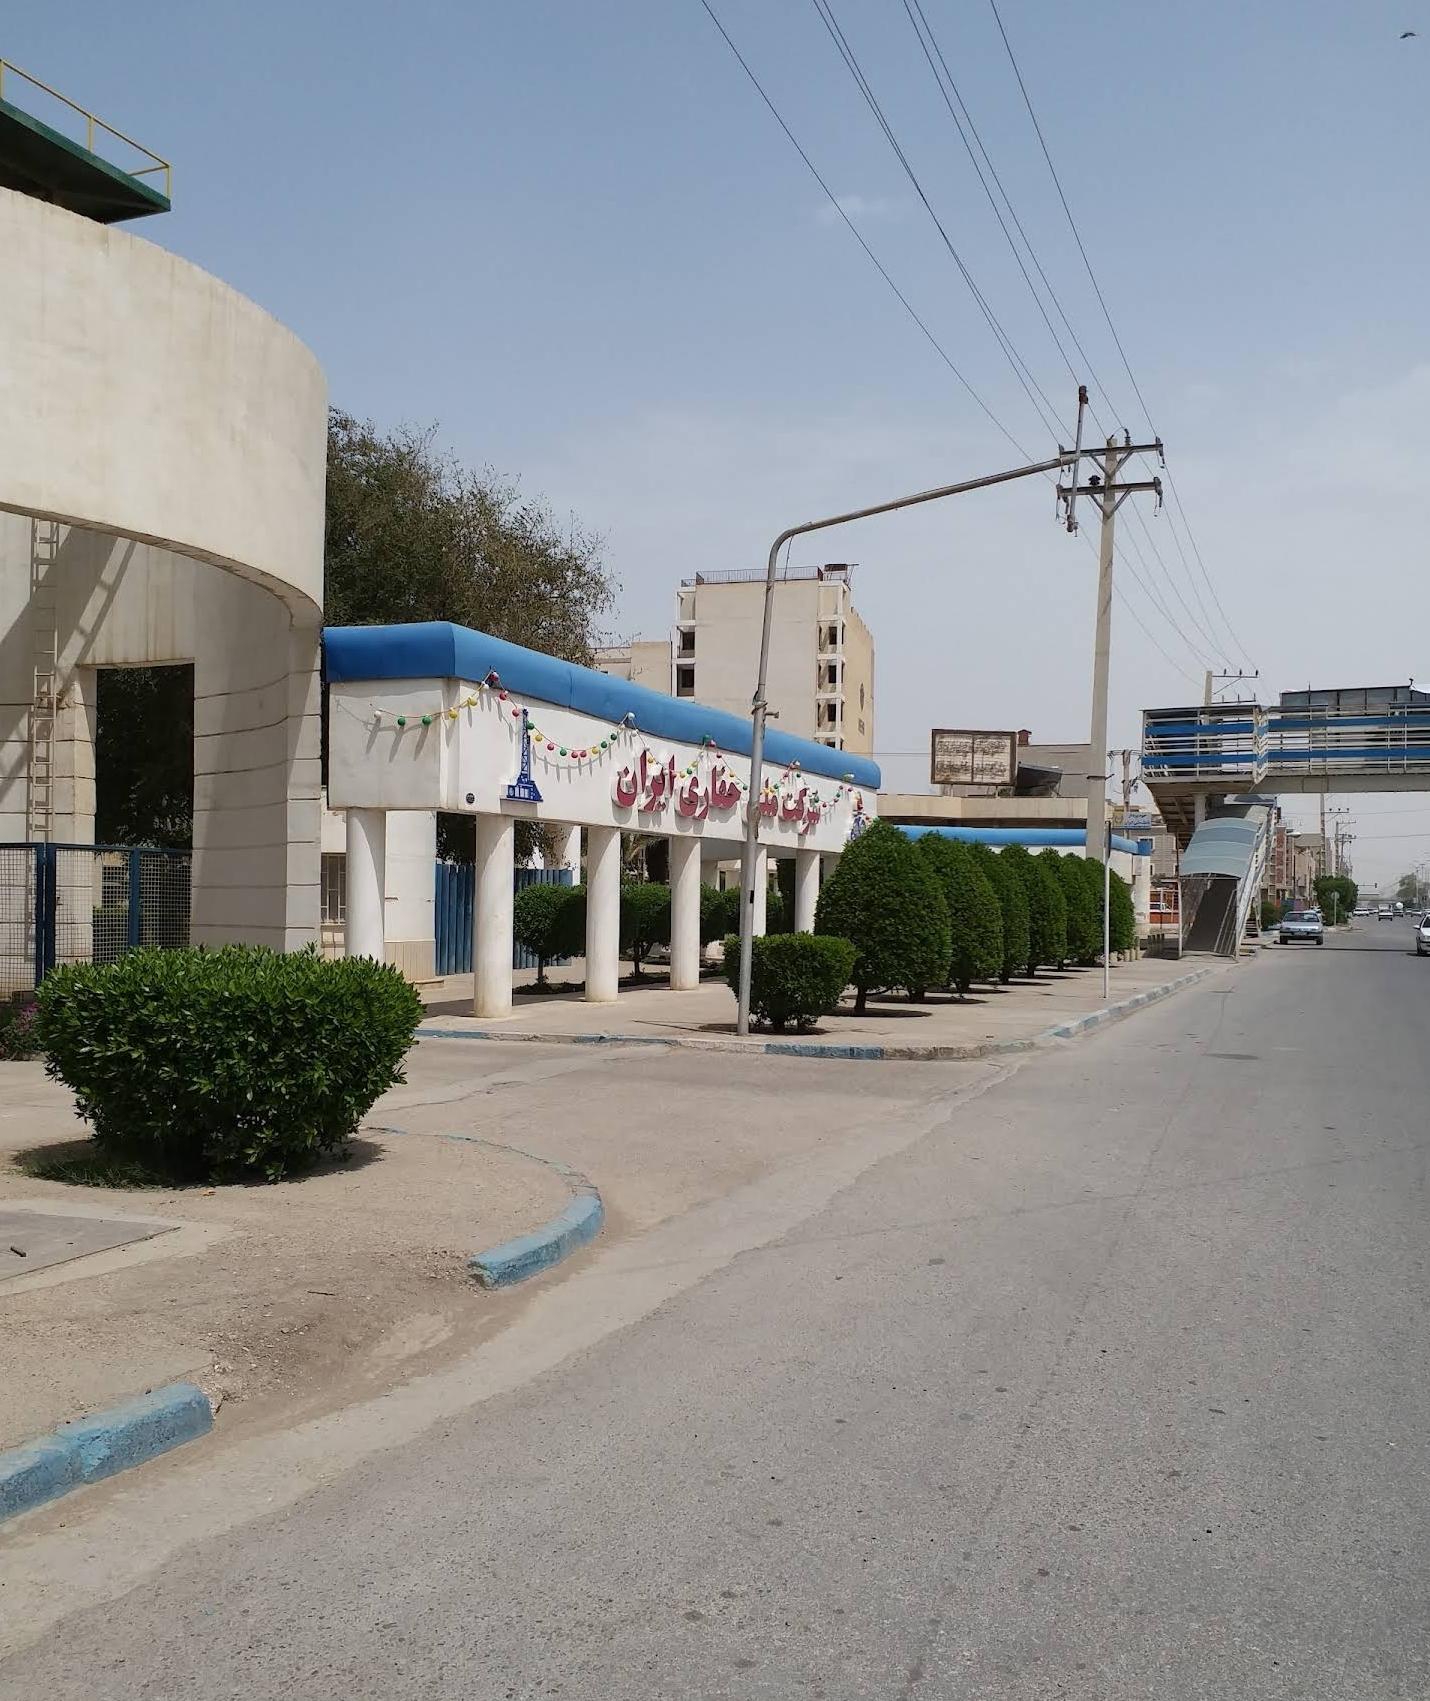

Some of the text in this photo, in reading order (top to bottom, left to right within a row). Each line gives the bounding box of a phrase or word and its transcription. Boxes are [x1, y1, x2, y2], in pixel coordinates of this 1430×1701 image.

[616, 750, 675, 817] ایران
[680, 765, 742, 820] حفاری
[781, 788, 820, 835] شرکت
